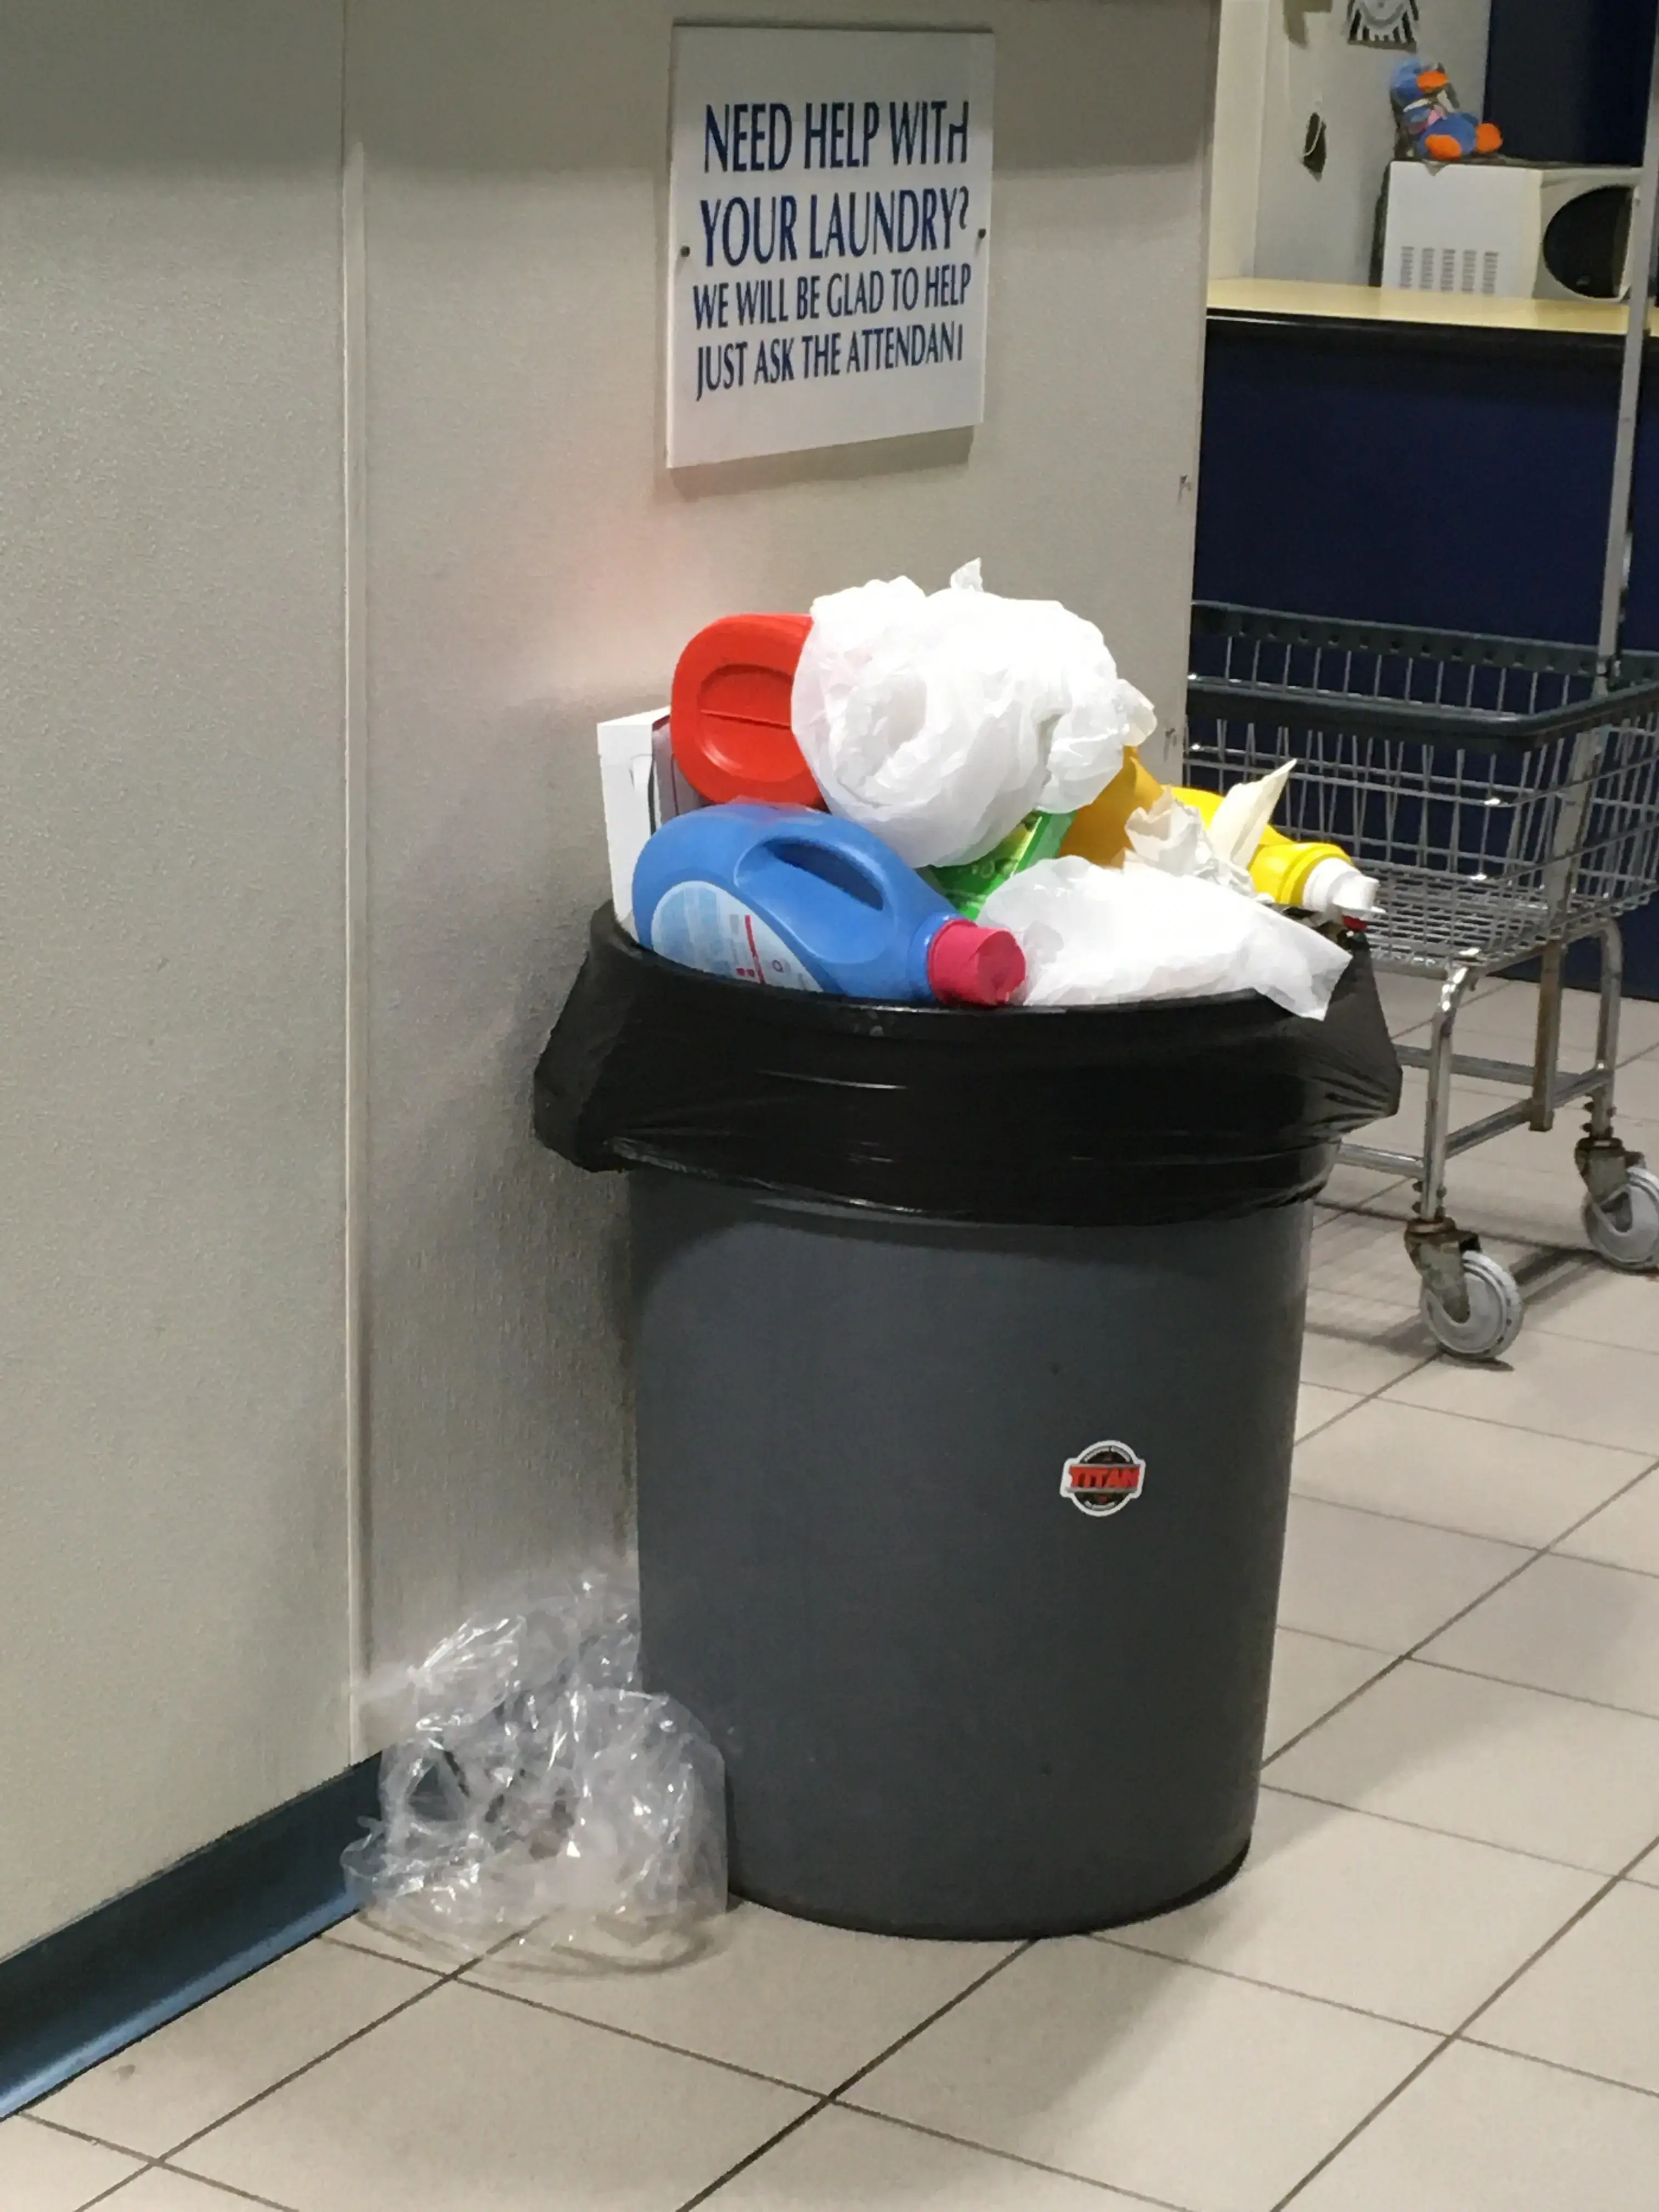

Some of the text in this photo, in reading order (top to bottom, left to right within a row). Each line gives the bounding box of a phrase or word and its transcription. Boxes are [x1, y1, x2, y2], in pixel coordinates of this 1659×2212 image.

[704, 100, 969, 173] NEED HELP WITH
[700, 185, 969, 267] YOUR LAUNDRY?
[692, 262, 972, 330] WE WILL BE GLAD TO HELP
[695, 341, 748, 402] JUST
[753, 337, 795, 385] ASK
[801, 332, 842, 380] THE
[1069, 1465, 1140, 1489] TITAN
